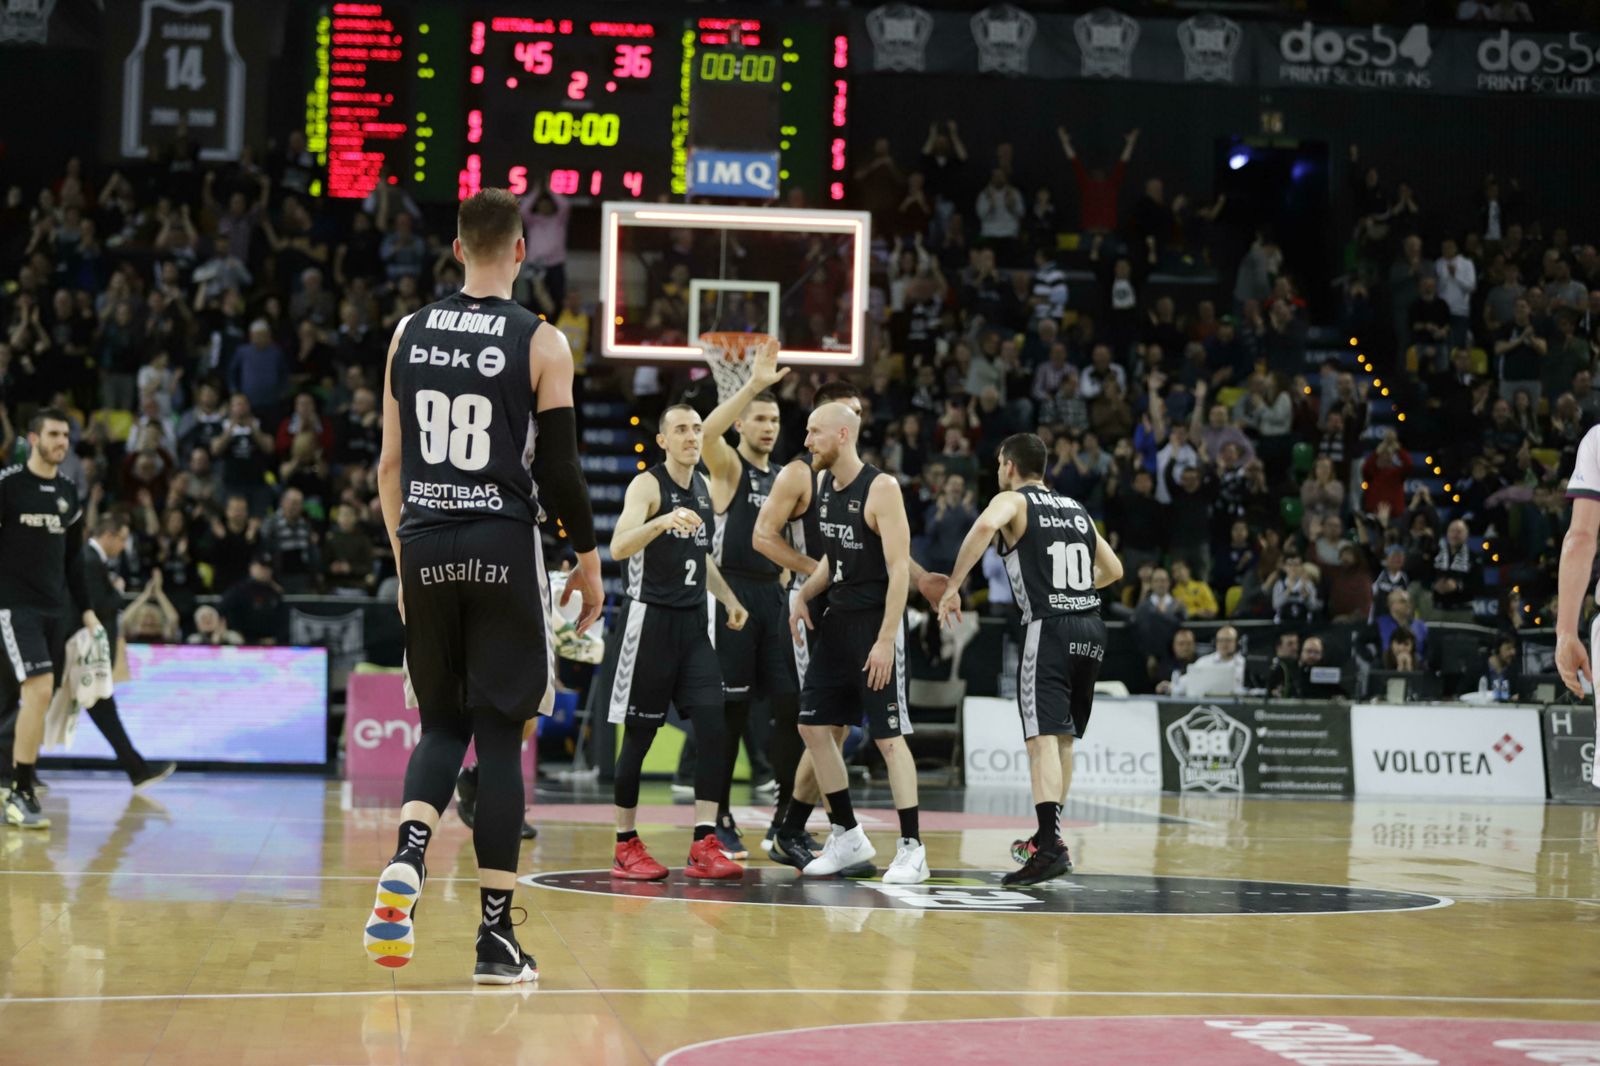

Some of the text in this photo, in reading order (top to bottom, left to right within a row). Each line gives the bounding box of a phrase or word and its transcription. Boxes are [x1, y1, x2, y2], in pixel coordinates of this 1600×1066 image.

[514, 41, 553, 75] 45
[1280, 21, 1431, 67] dos54
[1478, 29, 1600, 74] dos5
[164, 45, 206, 90] 14
[613, 44, 652, 78] 36
[701, 52, 776, 82] 00:00
[1279, 65, 1329, 81] PRINT
[568, 71, 588, 100] 2
[1478, 73, 1531, 91] PRINT
[533, 111, 620, 147] 00:00
[623, 171, 643, 196] 4
[697, 159, 774, 190] IMQ
[425, 308, 506, 337] KULBOKA
[409, 344, 472, 369] bbk
[415, 389, 493, 471] 98
[410, 480, 500, 499] BEOTIBAR
[820, 522, 854, 541] RETA
[420, 558, 509, 585] eusaltax
[684, 559, 697, 585] 2
[1047, 541, 1092, 591] 10
[969, 743, 1157, 775] conitac
[1373, 749, 1493, 775] VOLOTEA
